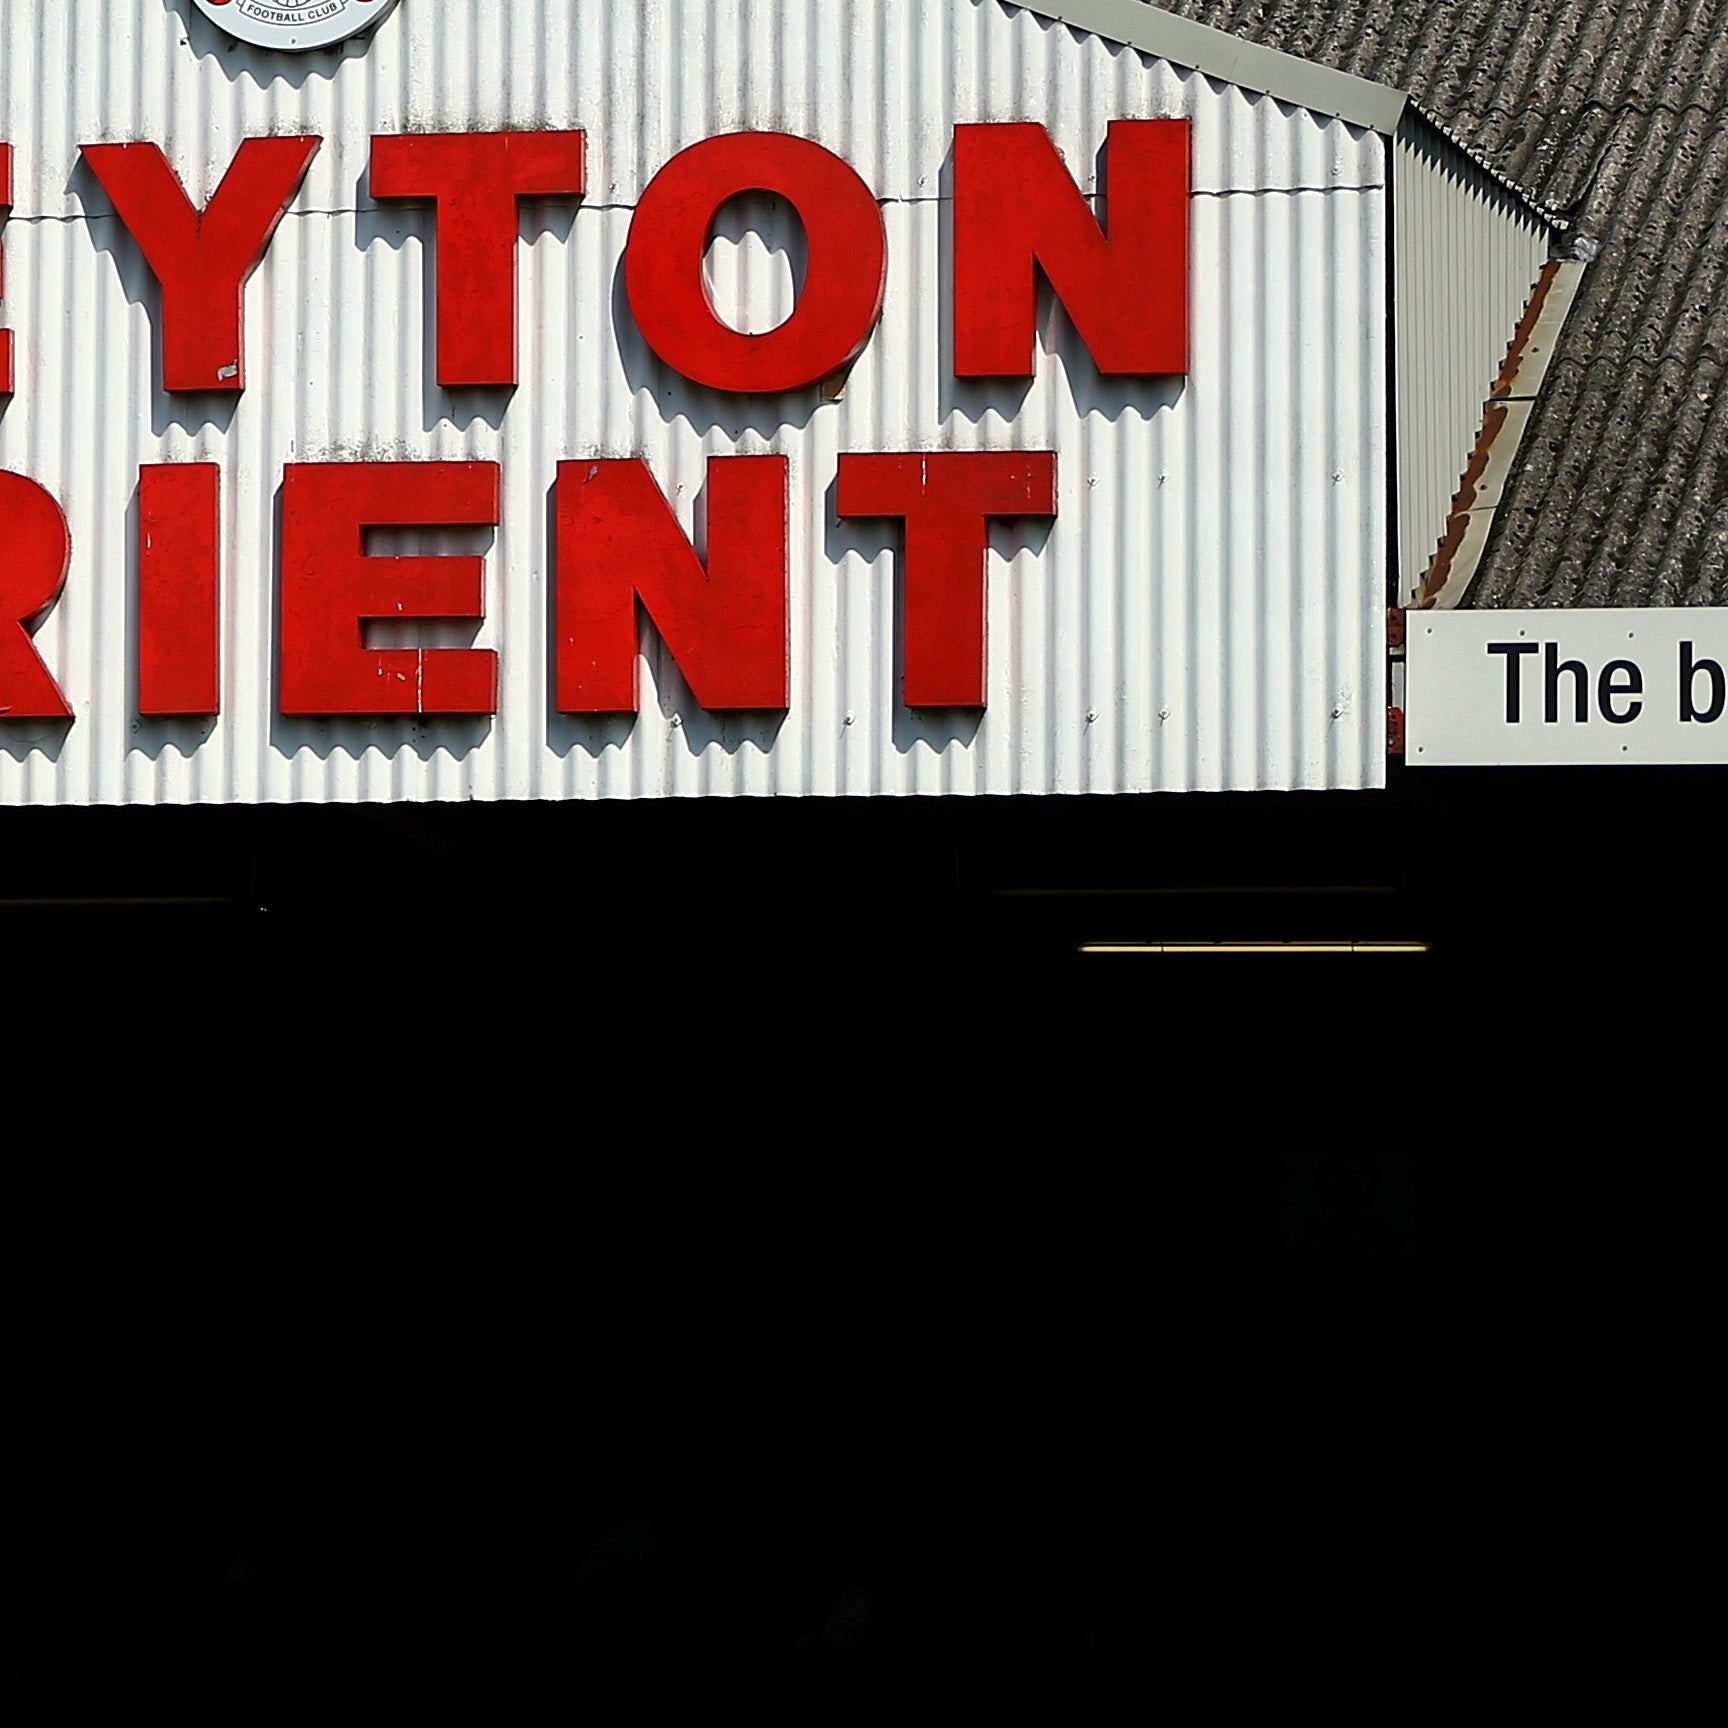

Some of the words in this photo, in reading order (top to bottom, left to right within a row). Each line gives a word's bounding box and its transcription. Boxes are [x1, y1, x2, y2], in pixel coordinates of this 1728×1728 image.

[247, 4, 304, 21] FOOTBALL
[308, 2, 337, 20] CLUB
[1487, 642, 1643, 724] The
